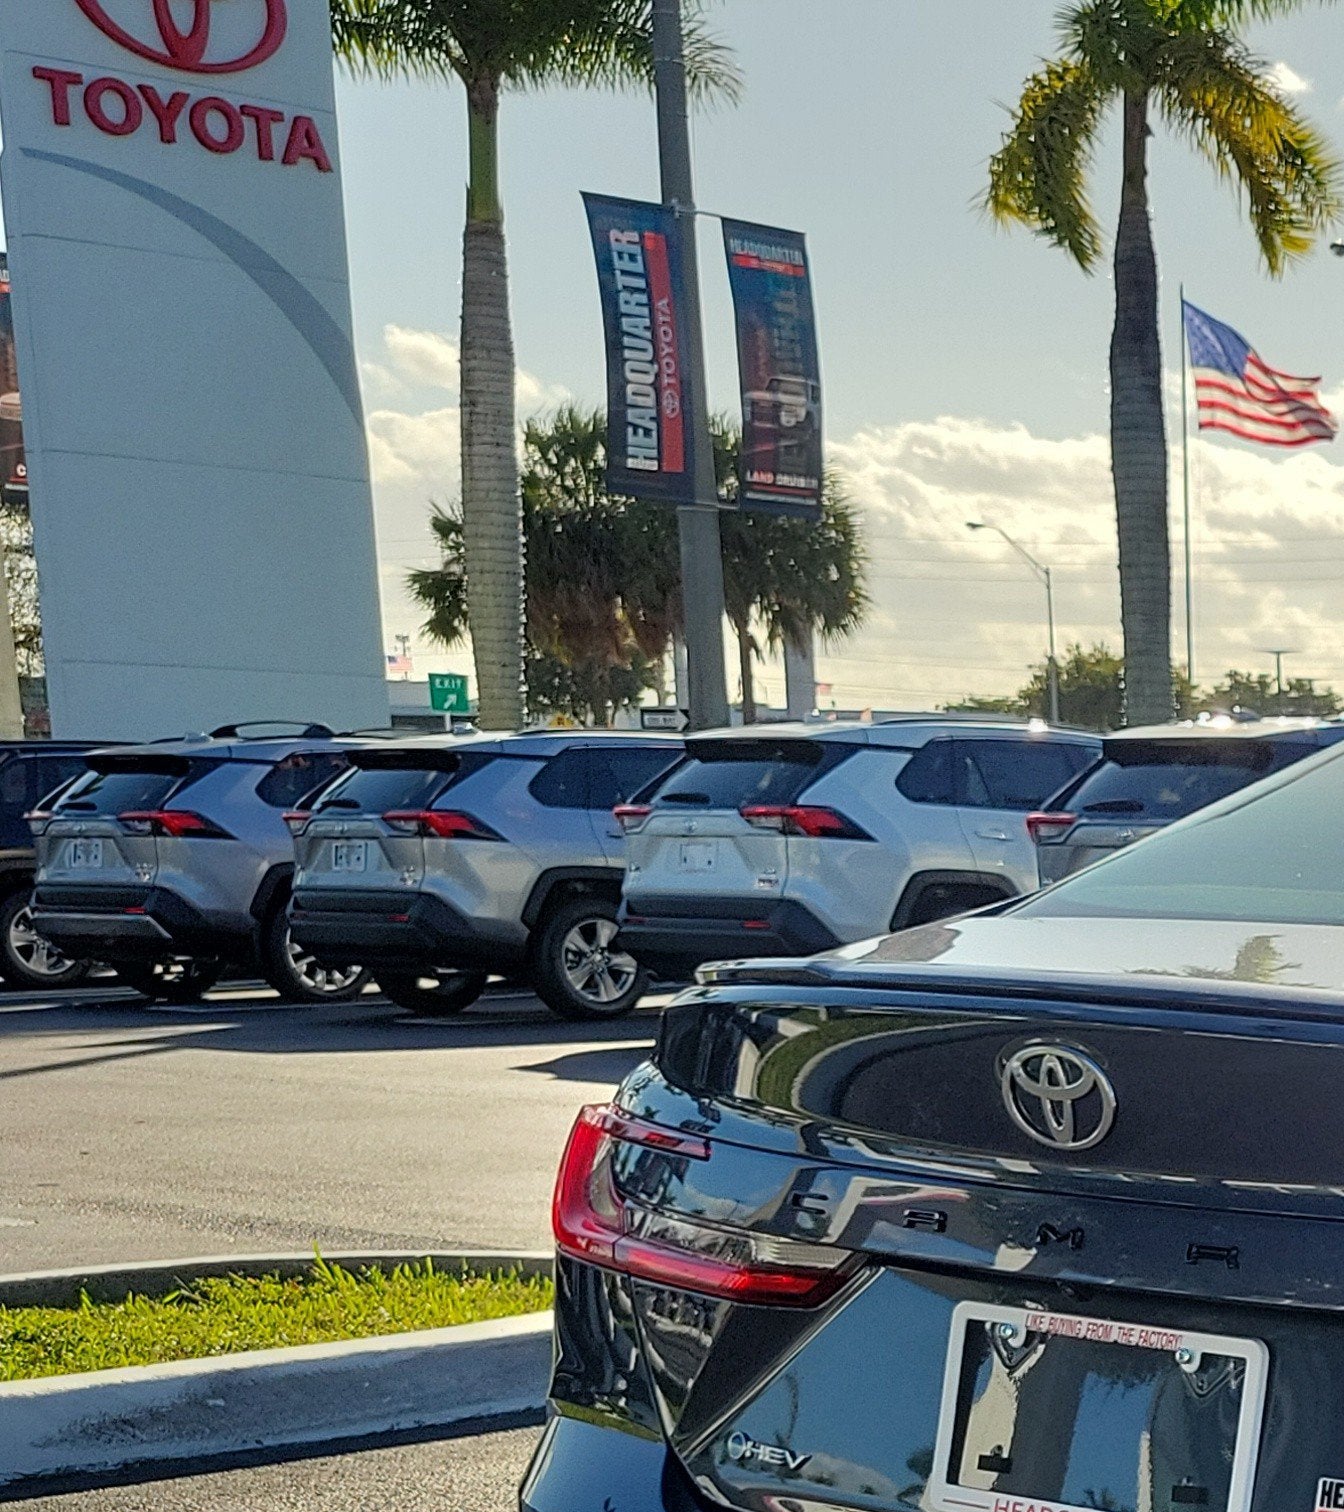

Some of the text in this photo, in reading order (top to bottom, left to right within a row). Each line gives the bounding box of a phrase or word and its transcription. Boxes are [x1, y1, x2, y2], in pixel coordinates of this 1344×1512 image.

[32, 66, 333, 173] TOYOTA
[608, 227, 660, 472] HEADQUARTER
[656, 298, 677, 385] TOYOTA
[746, 469, 775, 485] LAND
[434, 677, 463, 690] EXIT
[1026, 1313, 1044, 1330] LIKE
[1048, 1316, 1082, 1338] BUYING
[1086, 1321, 1113, 1341] FROM
[1117, 1326, 1134, 1344] THE
